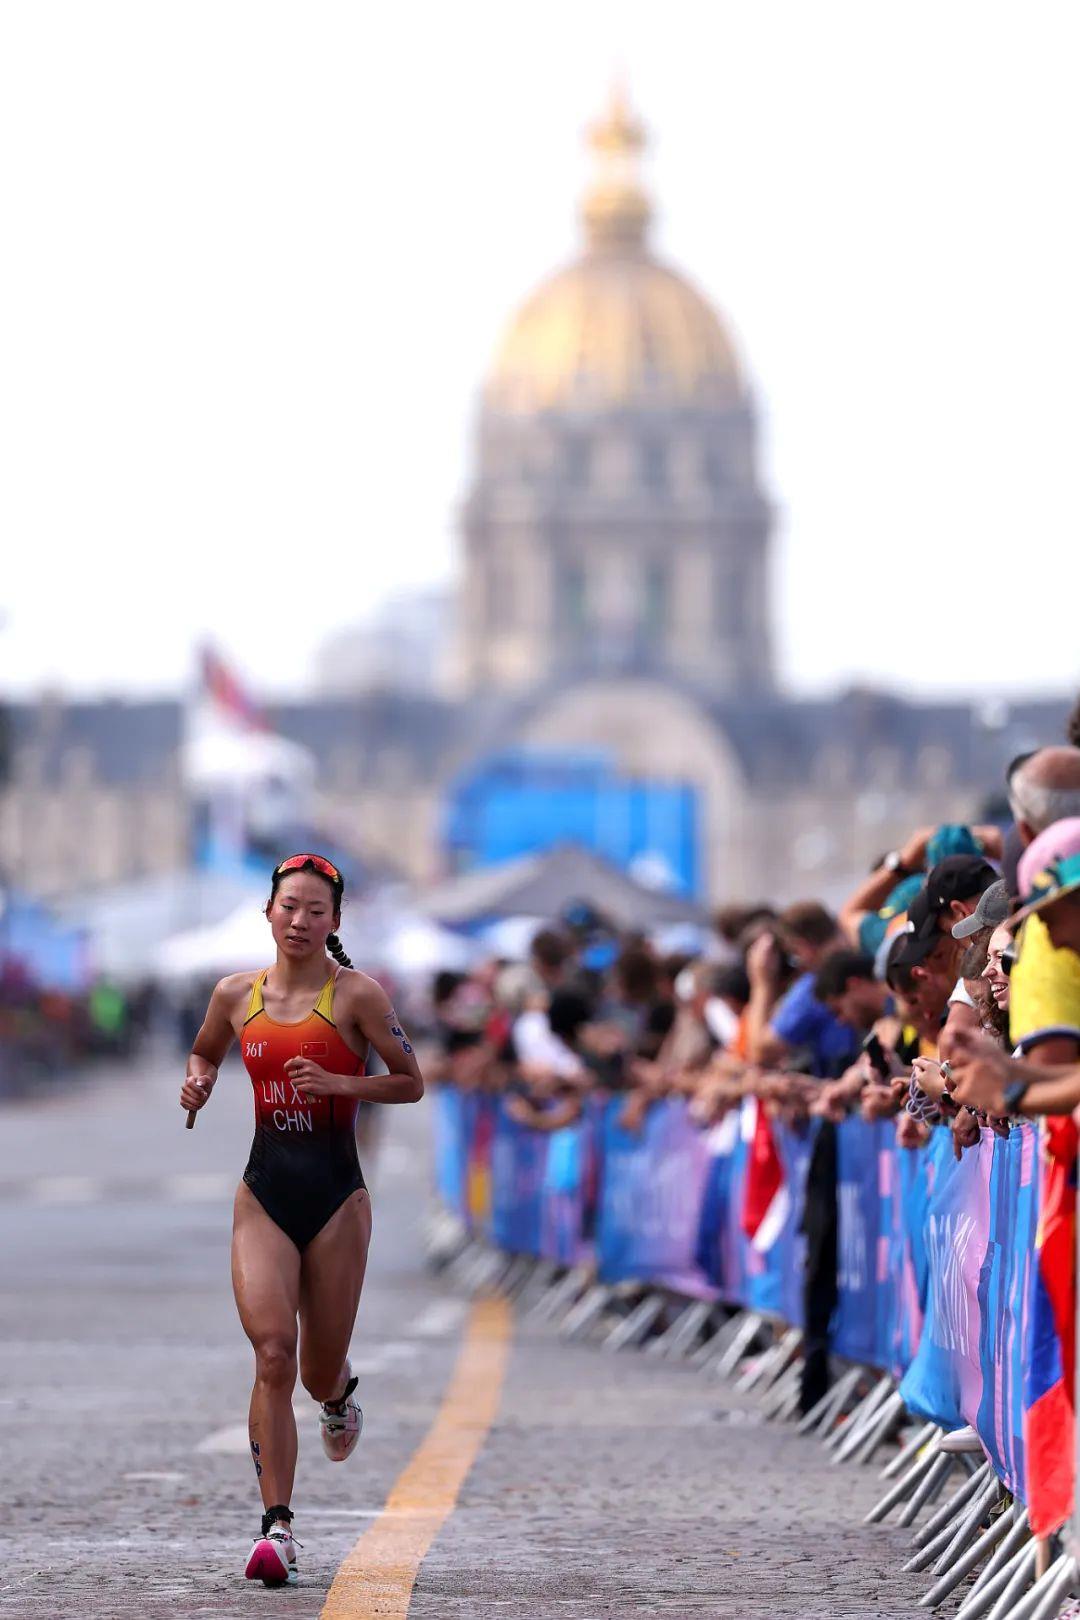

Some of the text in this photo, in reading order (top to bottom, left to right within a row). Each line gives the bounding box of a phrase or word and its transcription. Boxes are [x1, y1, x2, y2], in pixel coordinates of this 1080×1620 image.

[245, 1041, 268, 1058] 361°
[261, 1080, 322, 1105] LIN X..
[273, 1109, 313, 1132] CHN
